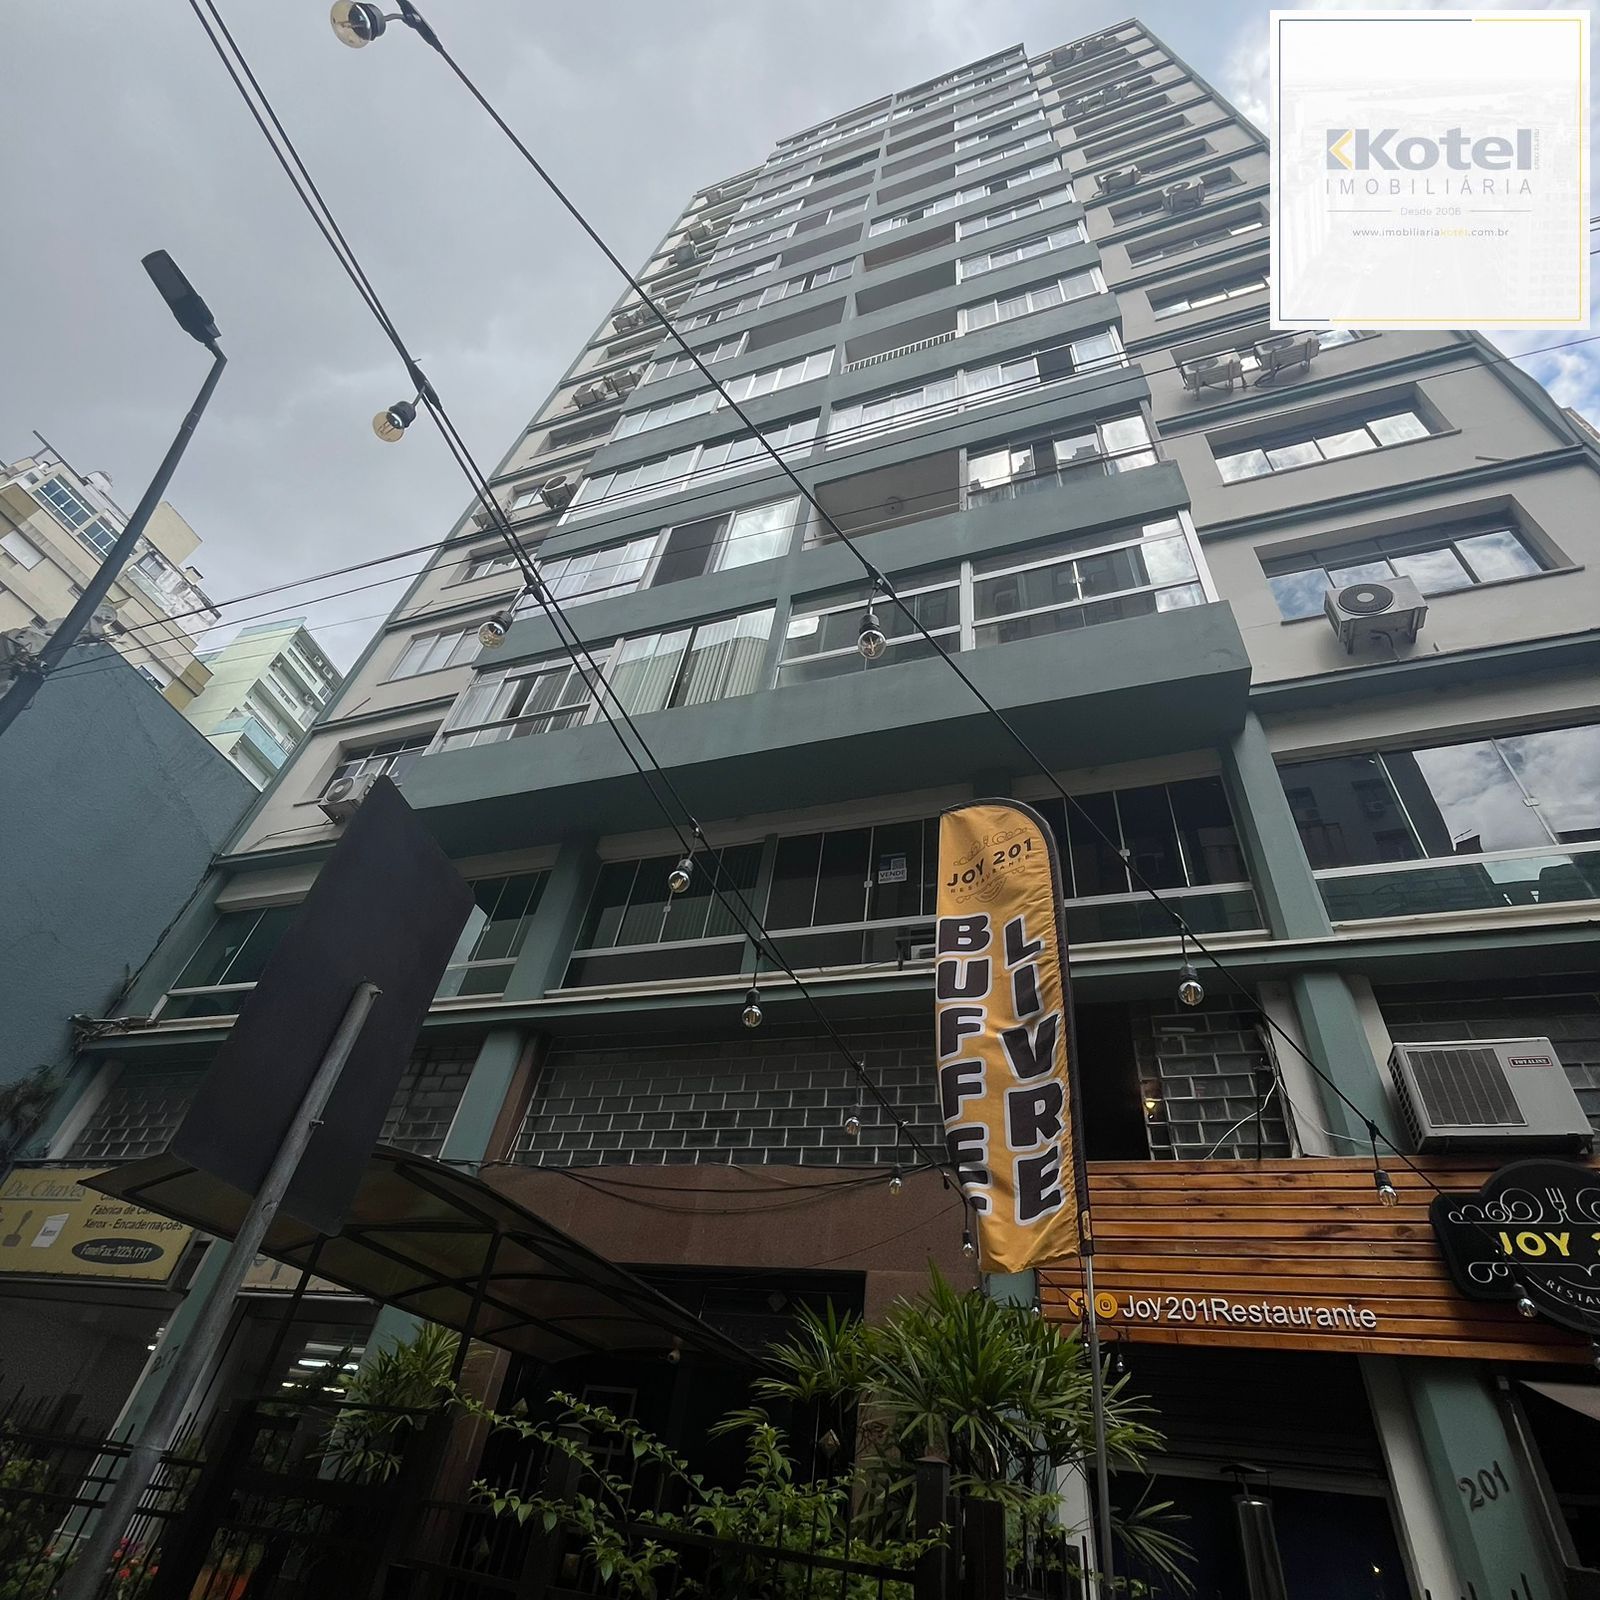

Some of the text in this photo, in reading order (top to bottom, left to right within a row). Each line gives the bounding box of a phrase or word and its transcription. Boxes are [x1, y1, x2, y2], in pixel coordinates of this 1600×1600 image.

[946, 837, 1032, 887] JOY 201
[1000, 914, 1064, 1223] LIVRE
[83, 1218, 107, 1229] Xerox
[1458, 1460, 1510, 1512] 201
